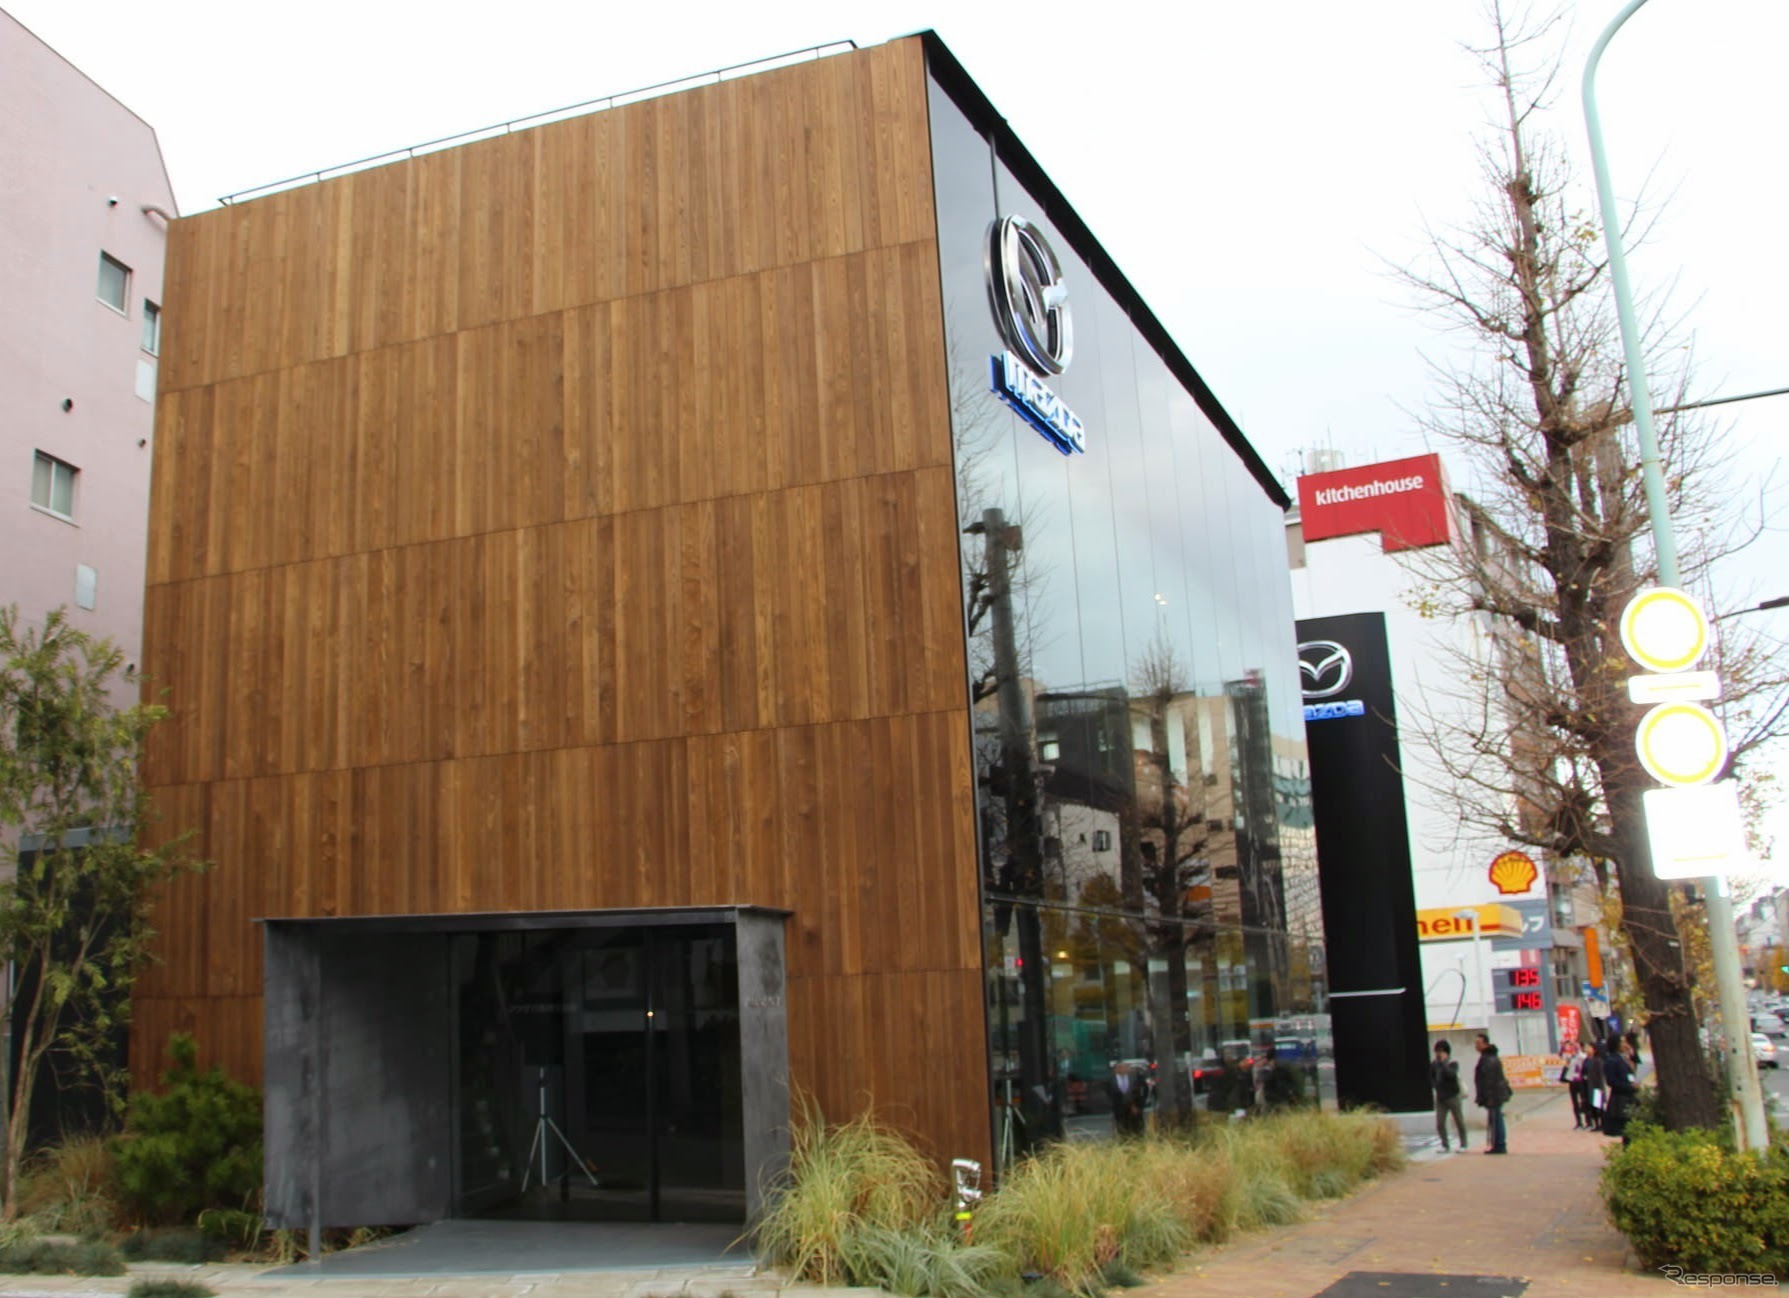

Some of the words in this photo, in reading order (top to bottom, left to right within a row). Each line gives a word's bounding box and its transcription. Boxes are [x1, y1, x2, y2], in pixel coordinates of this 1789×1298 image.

[1315, 475, 1424, 506] kitchenhouse
[1303, 700, 1365, 720] azda
[1514, 968, 1541, 987] 135
[1517, 991, 1543, 1010] 146
